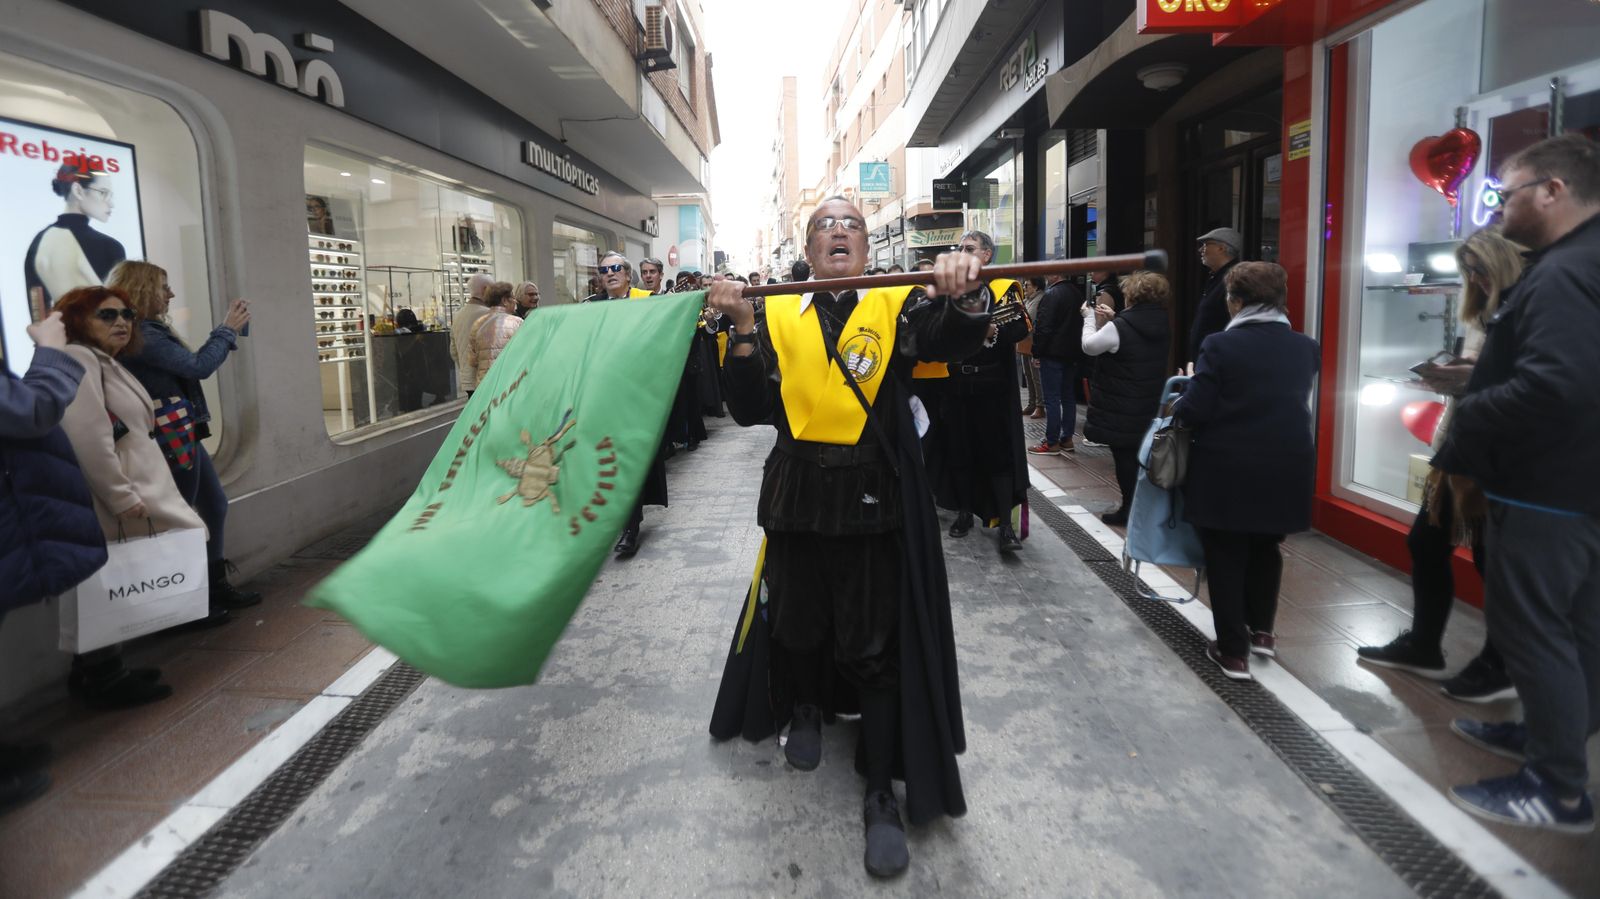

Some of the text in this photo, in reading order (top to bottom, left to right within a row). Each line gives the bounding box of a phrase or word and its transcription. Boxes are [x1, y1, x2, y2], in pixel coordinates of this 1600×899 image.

[1000, 30, 1038, 92] RETA
[0, 131, 120, 174] Rebajas
[569, 436, 618, 536] SEVILLA
[108, 572, 186, 601] MANGO
